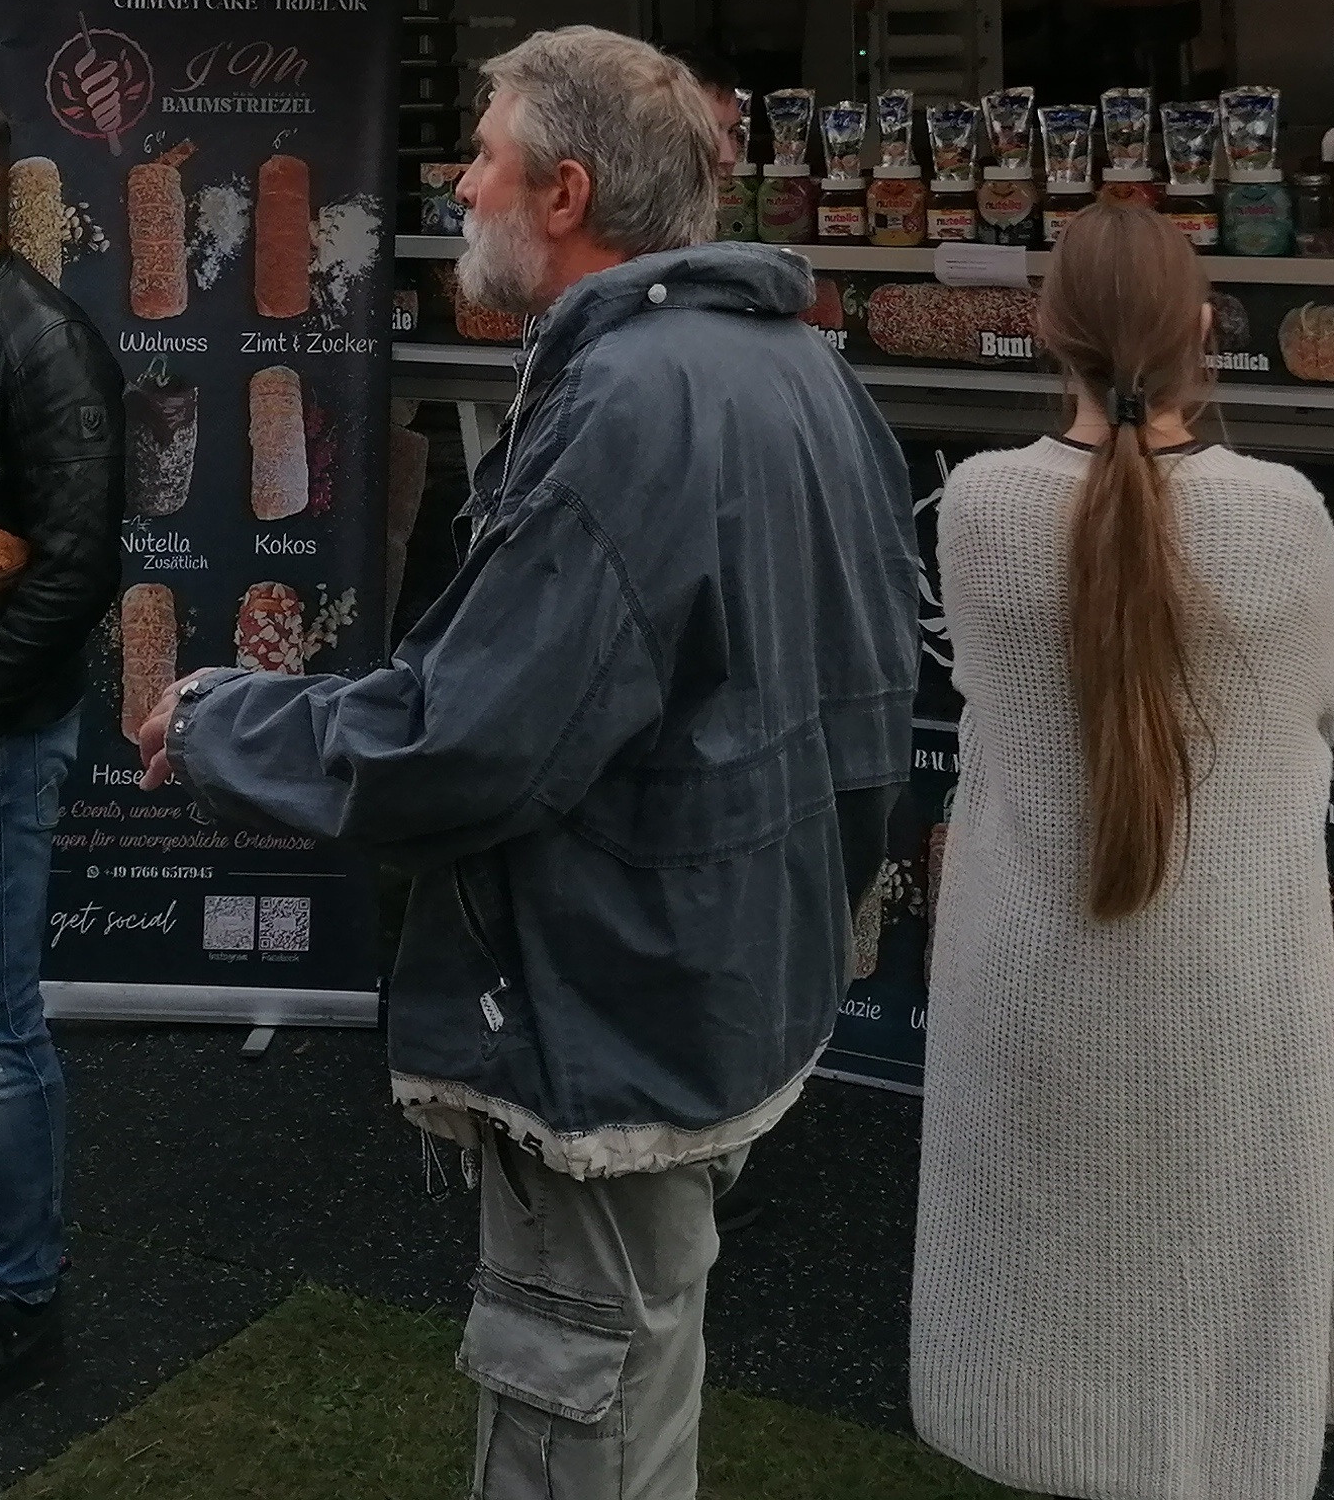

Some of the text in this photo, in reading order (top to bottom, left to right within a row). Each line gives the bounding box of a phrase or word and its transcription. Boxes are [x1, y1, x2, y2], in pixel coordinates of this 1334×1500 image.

[161, 96, 316, 114] BAUMSTRIEZEL
[824, 211, 860, 224] nutella
[118, 332, 208, 353] Walnuss
[240, 332, 287, 353] Zimt
[305, 333, 378, 354] Zucker
[980, 331, 1033, 358] Bunt
[255, 533, 317, 555] Kokos
[143, 553, 209, 571] Zusätlich
[131, 866, 159, 879] 1766
[50, 899, 178, 949] get social
